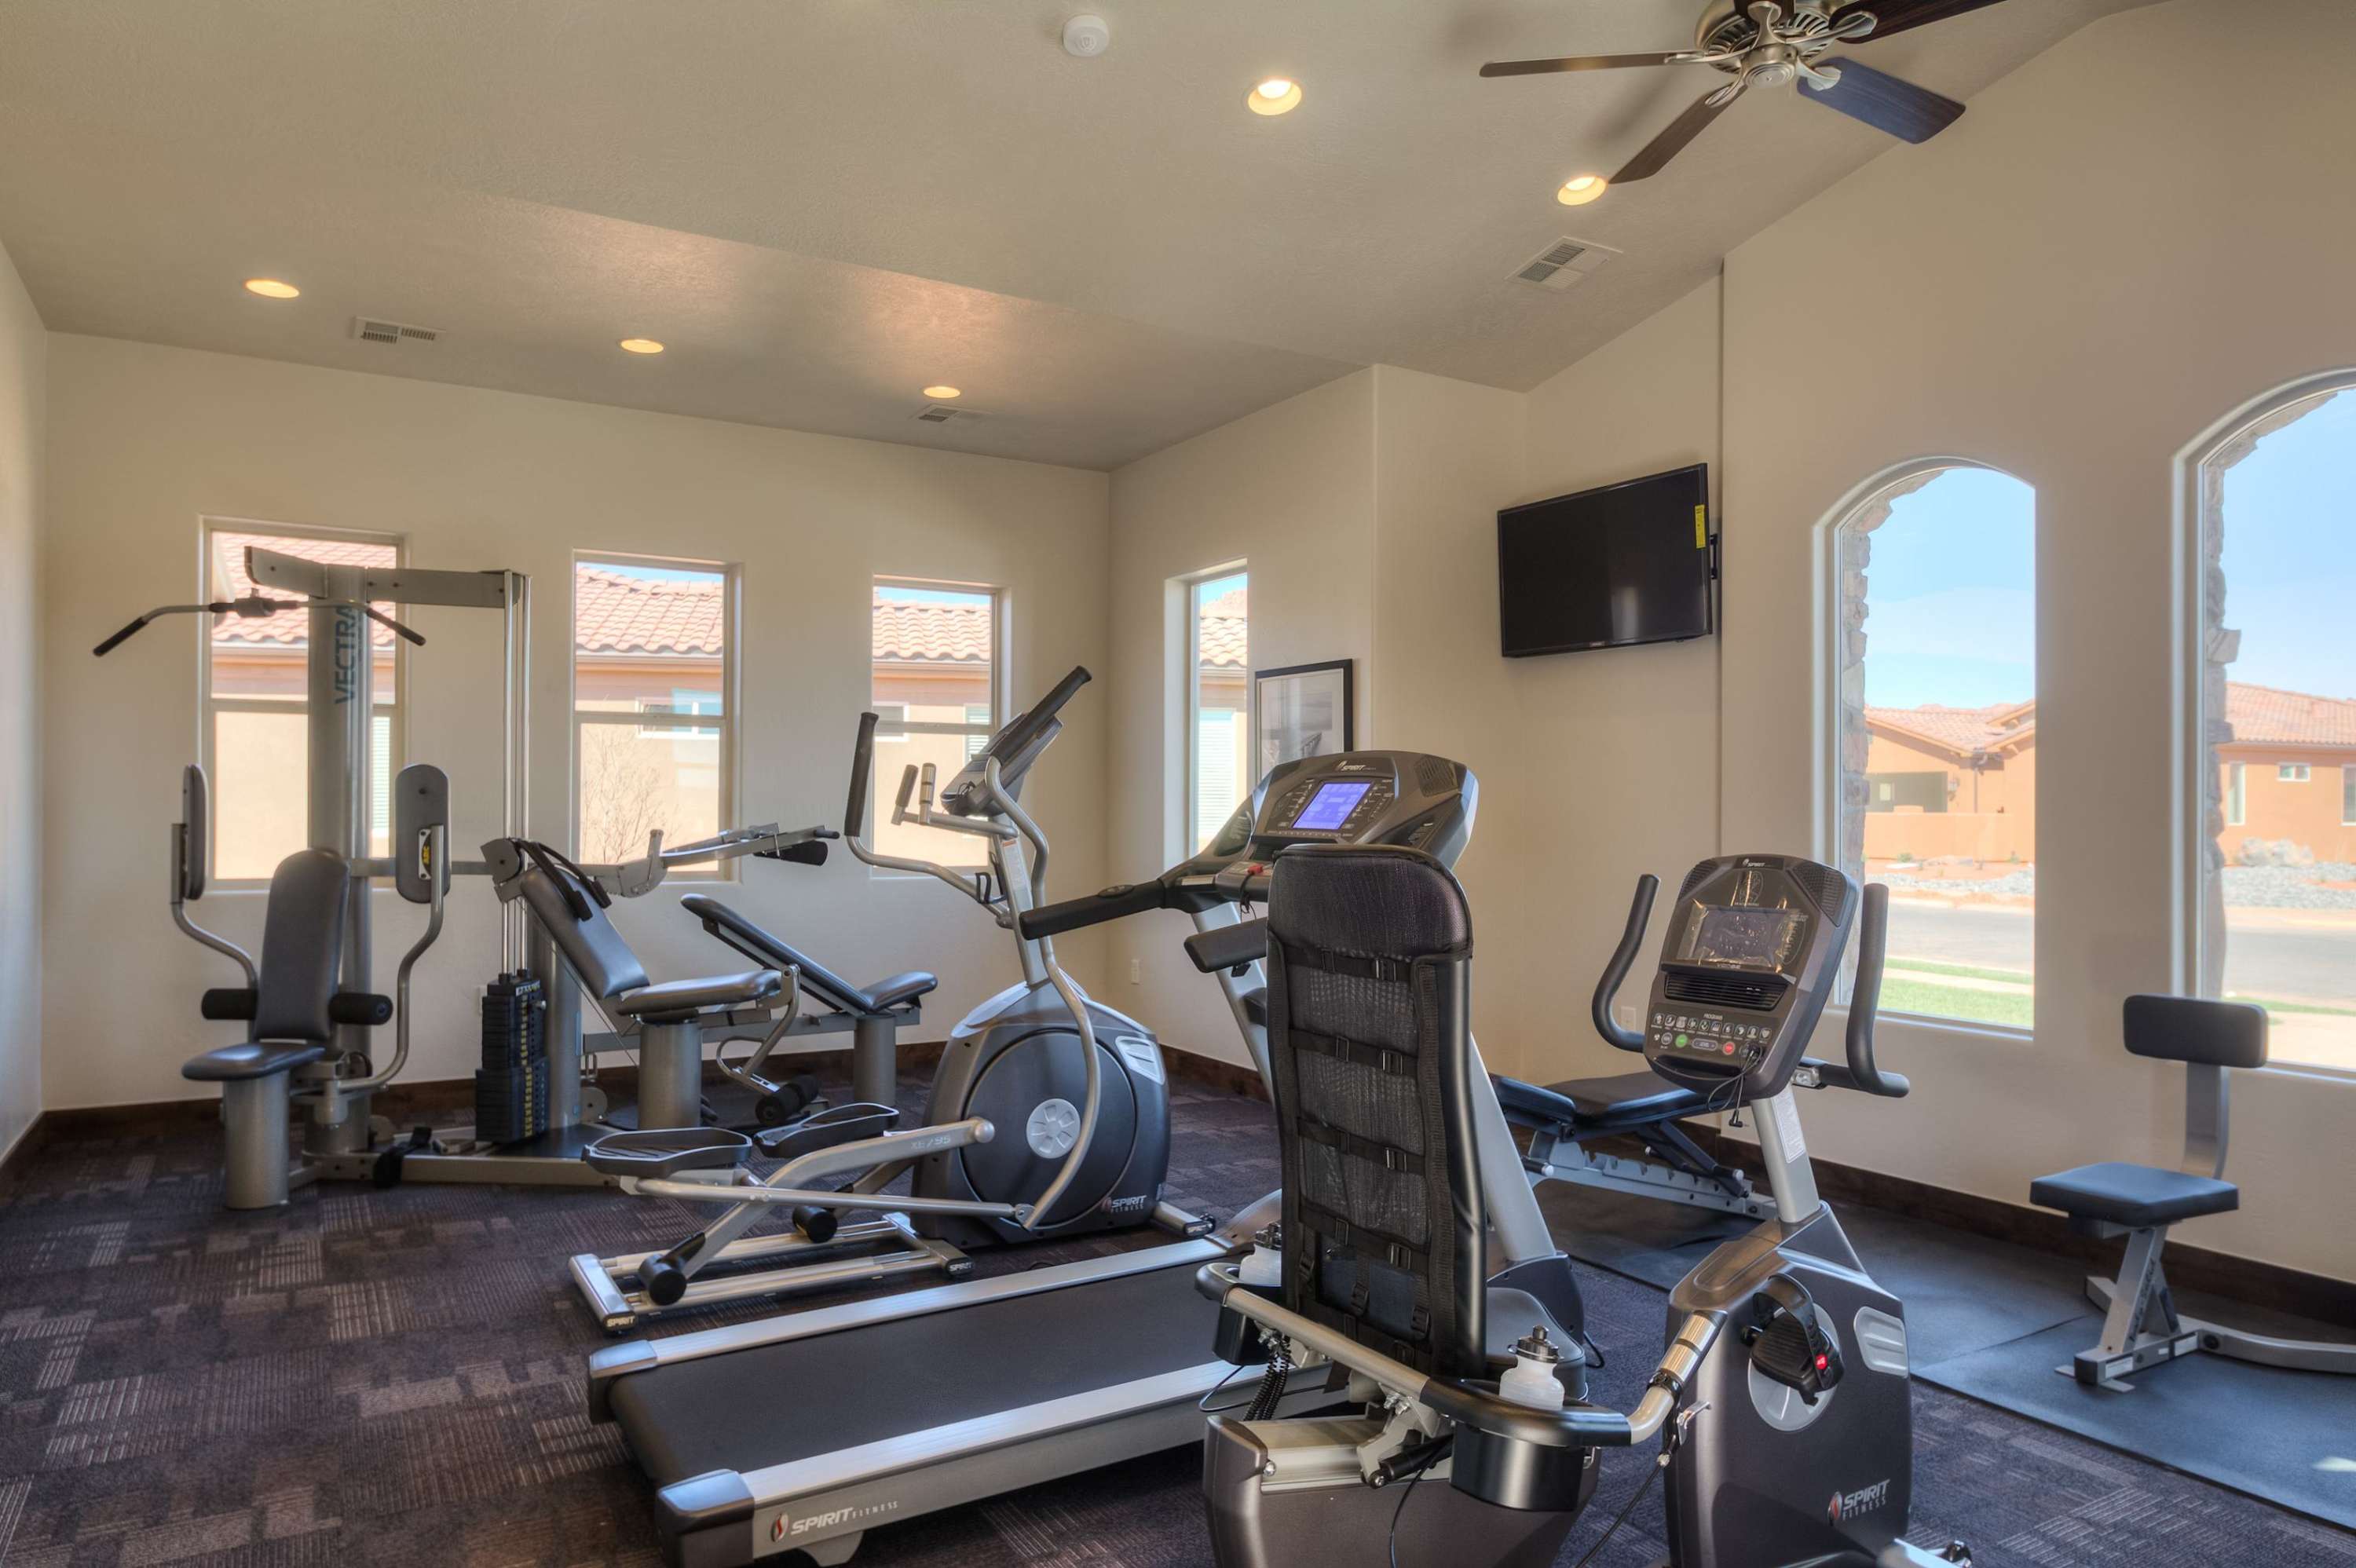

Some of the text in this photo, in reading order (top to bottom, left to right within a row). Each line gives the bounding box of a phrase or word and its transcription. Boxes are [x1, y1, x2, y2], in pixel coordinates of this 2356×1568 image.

[335, 605, 356, 704] VECTRA
[1111, 1195, 1147, 1208] SPIRIT
[607, 1316, 635, 1327] SPIRIT
[1842, 1478, 1890, 1511] SPIRIT
[1842, 1495, 1886, 1521] FITNESS
[791, 1501, 898, 1535] SPIRIT FITNESS
